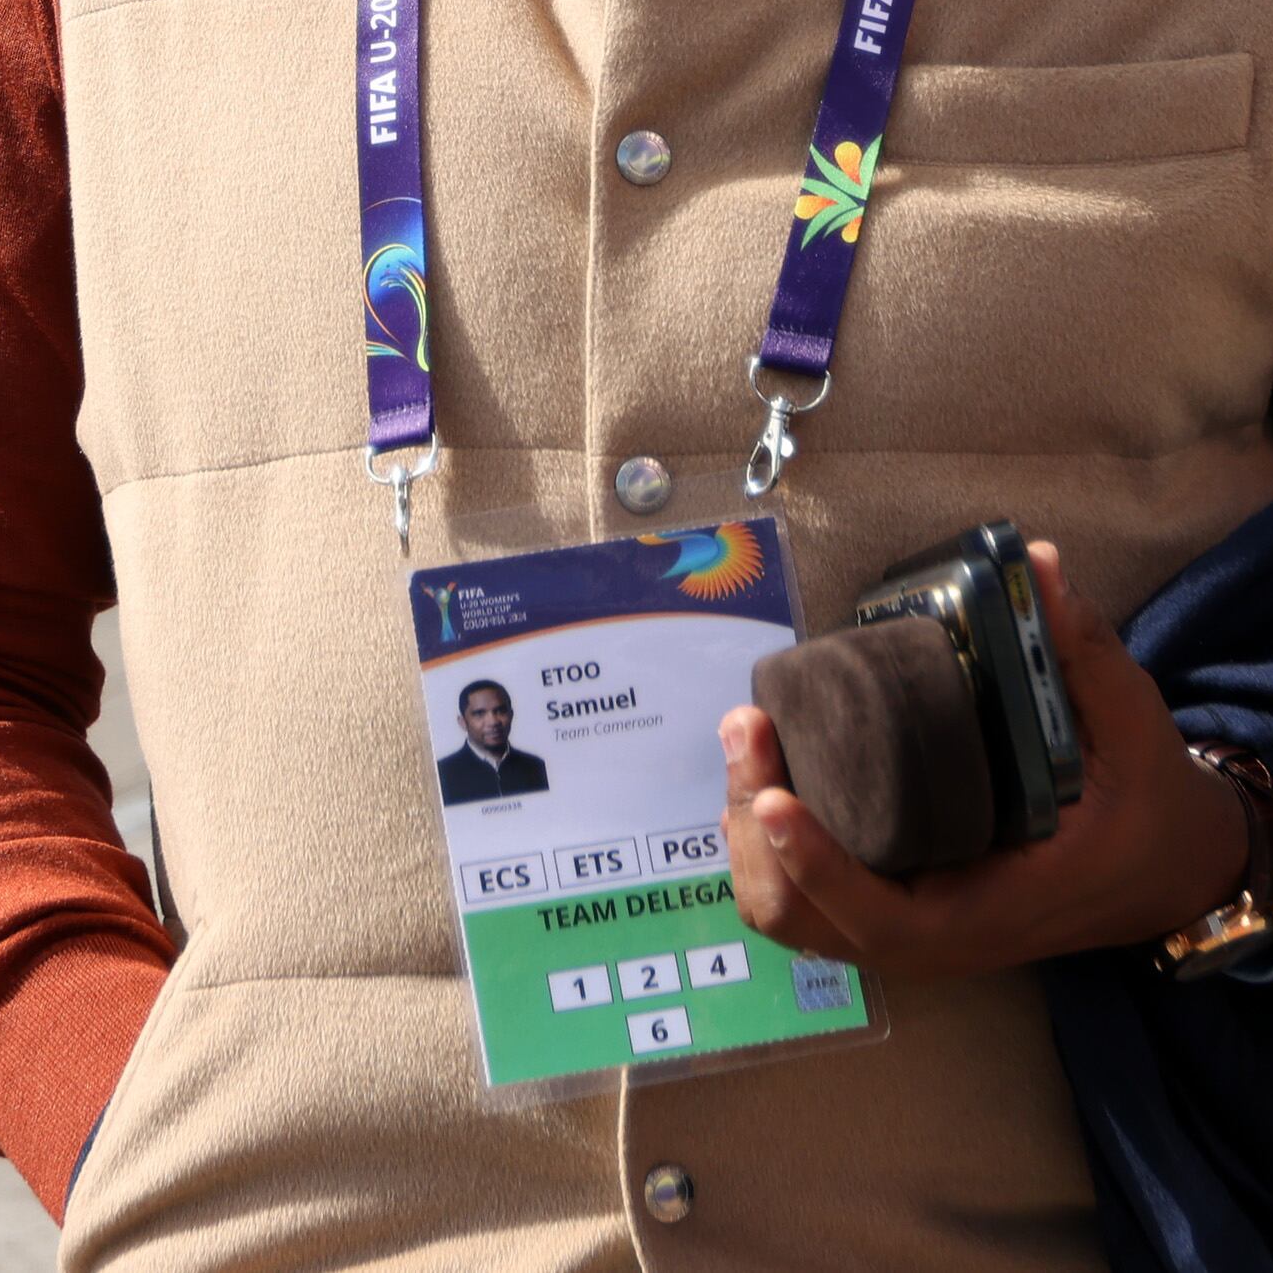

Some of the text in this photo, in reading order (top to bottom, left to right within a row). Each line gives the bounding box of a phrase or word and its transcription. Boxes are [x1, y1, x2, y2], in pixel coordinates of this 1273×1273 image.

[369, 70, 397, 145] FIFA
[458, 587, 485, 600] FIFA
[460, 592, 520, 610] U-20 WOMEN'S
[462, 604, 512, 619] WORLD CUP
[541, 661, 601, 687] ETOO
[546, 686, 637, 721] Samuel
[554, 714, 664, 742] Team Cameroon
[479, 833, 719, 894] ECS ETS PGS
[537, 879, 736, 932] TEAM DELEGA
[572, 953, 727, 1001] 1 2 4
[651, 1018, 669, 1043] 6
